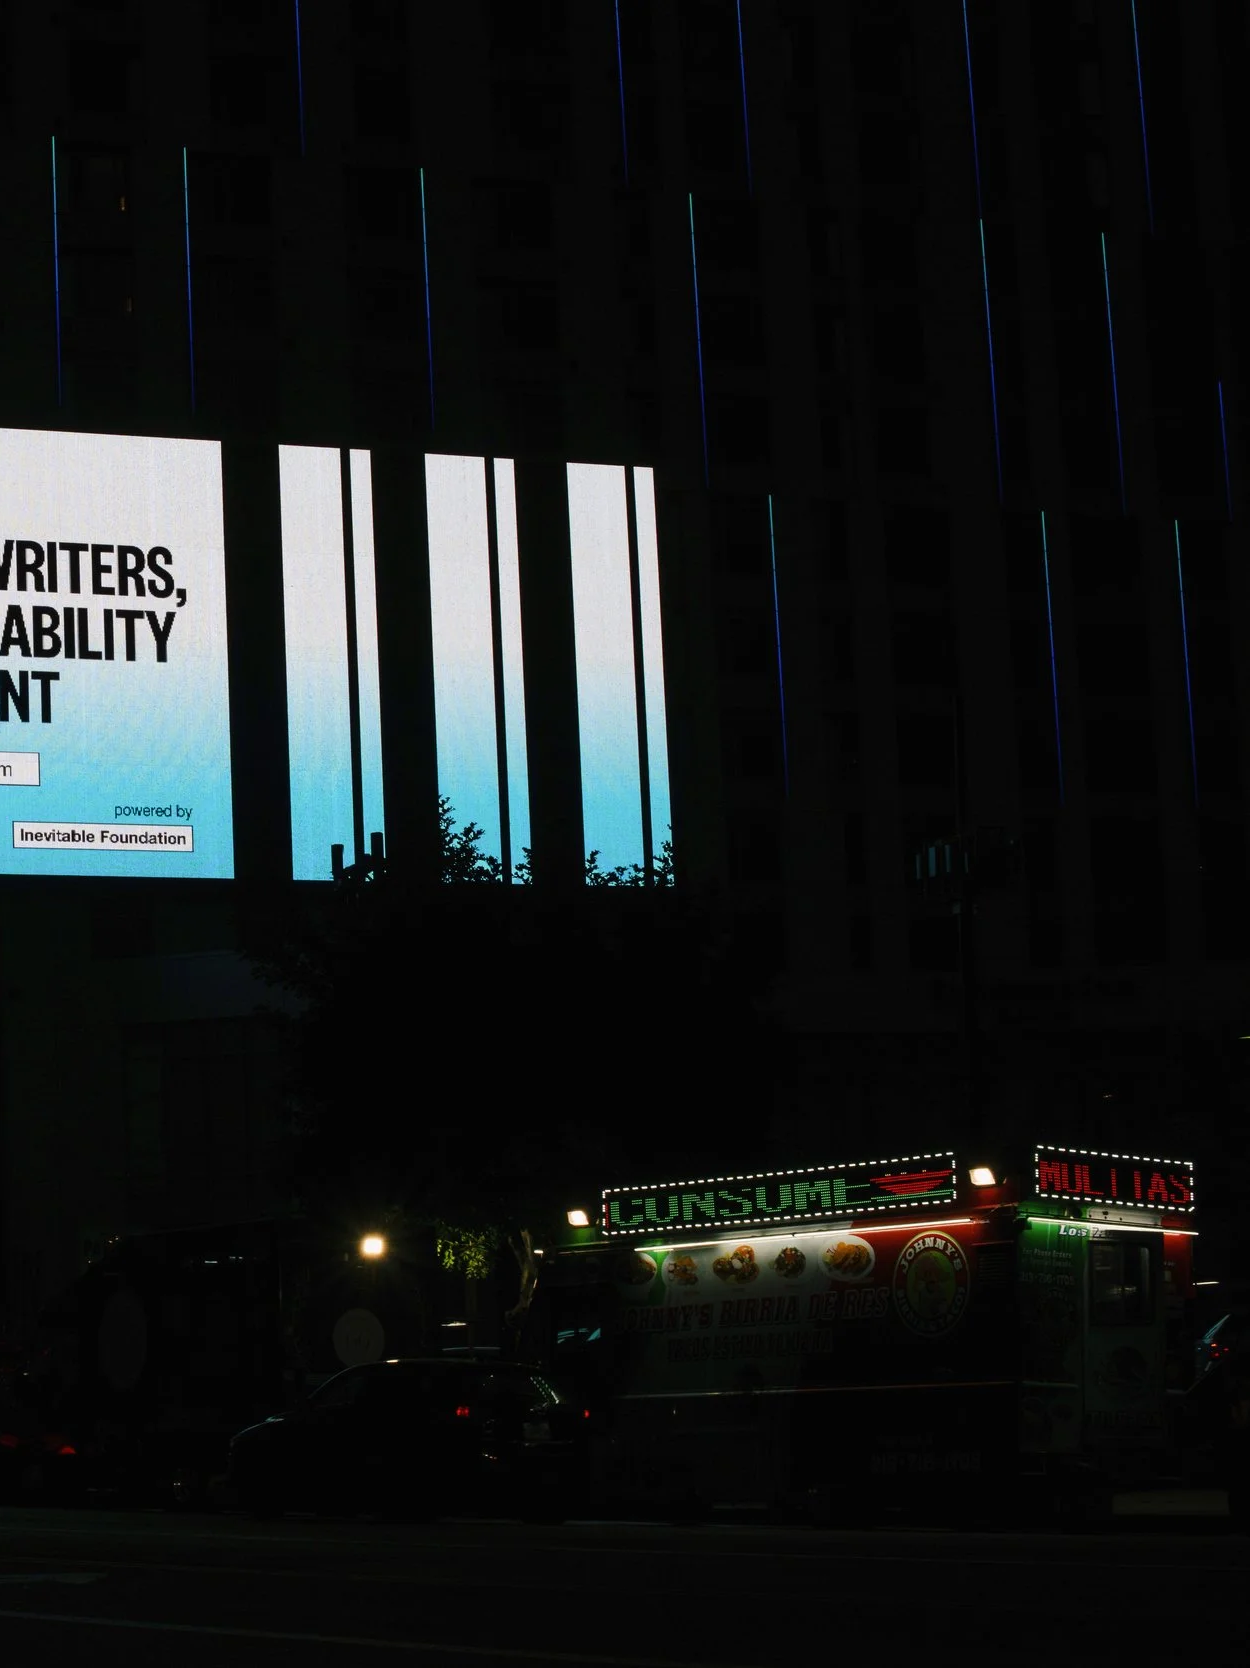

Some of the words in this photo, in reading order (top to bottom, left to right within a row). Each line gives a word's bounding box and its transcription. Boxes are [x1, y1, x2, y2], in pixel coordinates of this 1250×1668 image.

[114, 803, 172, 822] powered
[175, 803, 193, 822] by
[20, 828, 95, 844] Inevitable
[100, 829, 187, 846] Foundation
[900, 1237, 963, 1275] JOHNNY'S
[717, 1295, 800, 1327] BIRRIA
[806, 1290, 837, 1323] DE
[841, 1286, 890, 1320] RES
